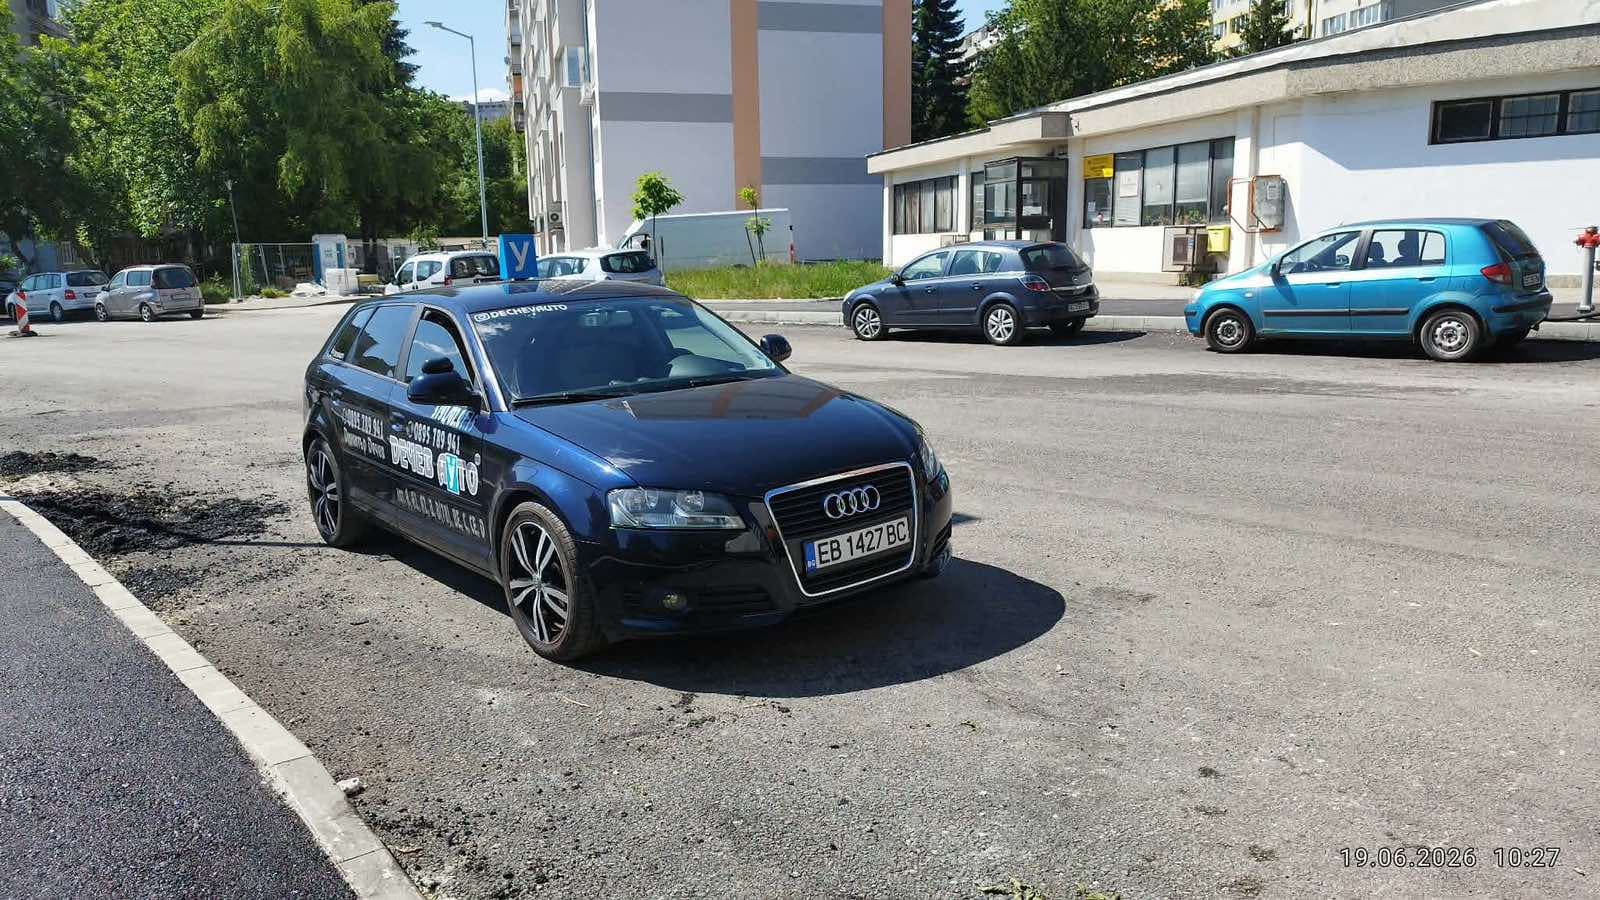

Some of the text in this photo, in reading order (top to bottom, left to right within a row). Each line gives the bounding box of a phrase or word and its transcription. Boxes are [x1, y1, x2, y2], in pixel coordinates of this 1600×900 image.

[509, 241, 530, 272] У
[490, 304, 568, 319] DECHEVAUTO
[414, 421, 461, 456] 0895 789 941
[818, 521, 907, 565] EB 1427 BC
